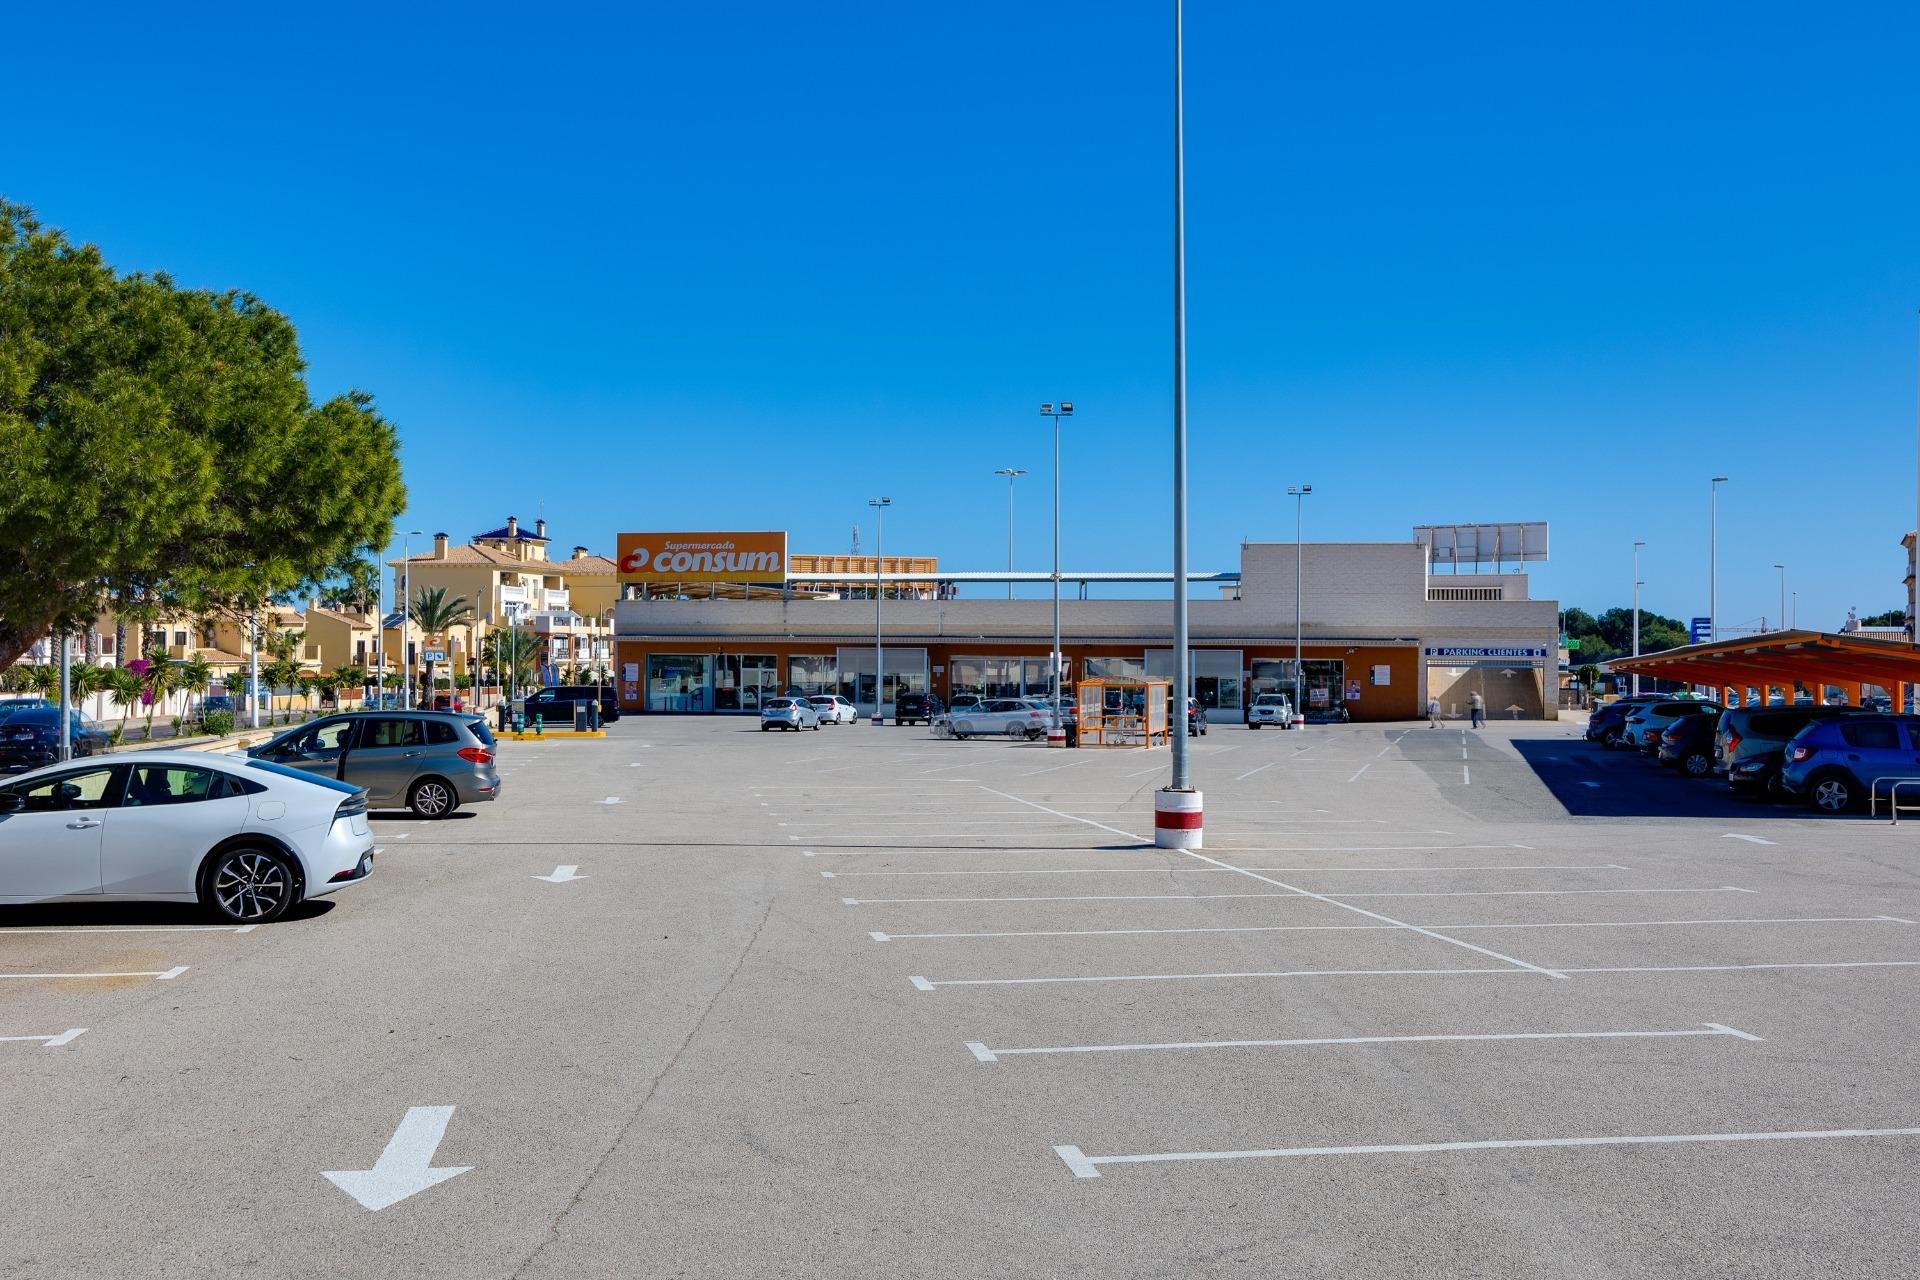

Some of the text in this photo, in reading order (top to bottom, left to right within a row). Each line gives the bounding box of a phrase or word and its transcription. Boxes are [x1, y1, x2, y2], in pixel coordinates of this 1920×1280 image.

[664, 541, 734, 551] Supermercado
[653, 551, 780, 572] consum
[1443, 648, 1485, 656] PARKING
[1487, 648, 1528, 656] CLIENTES
